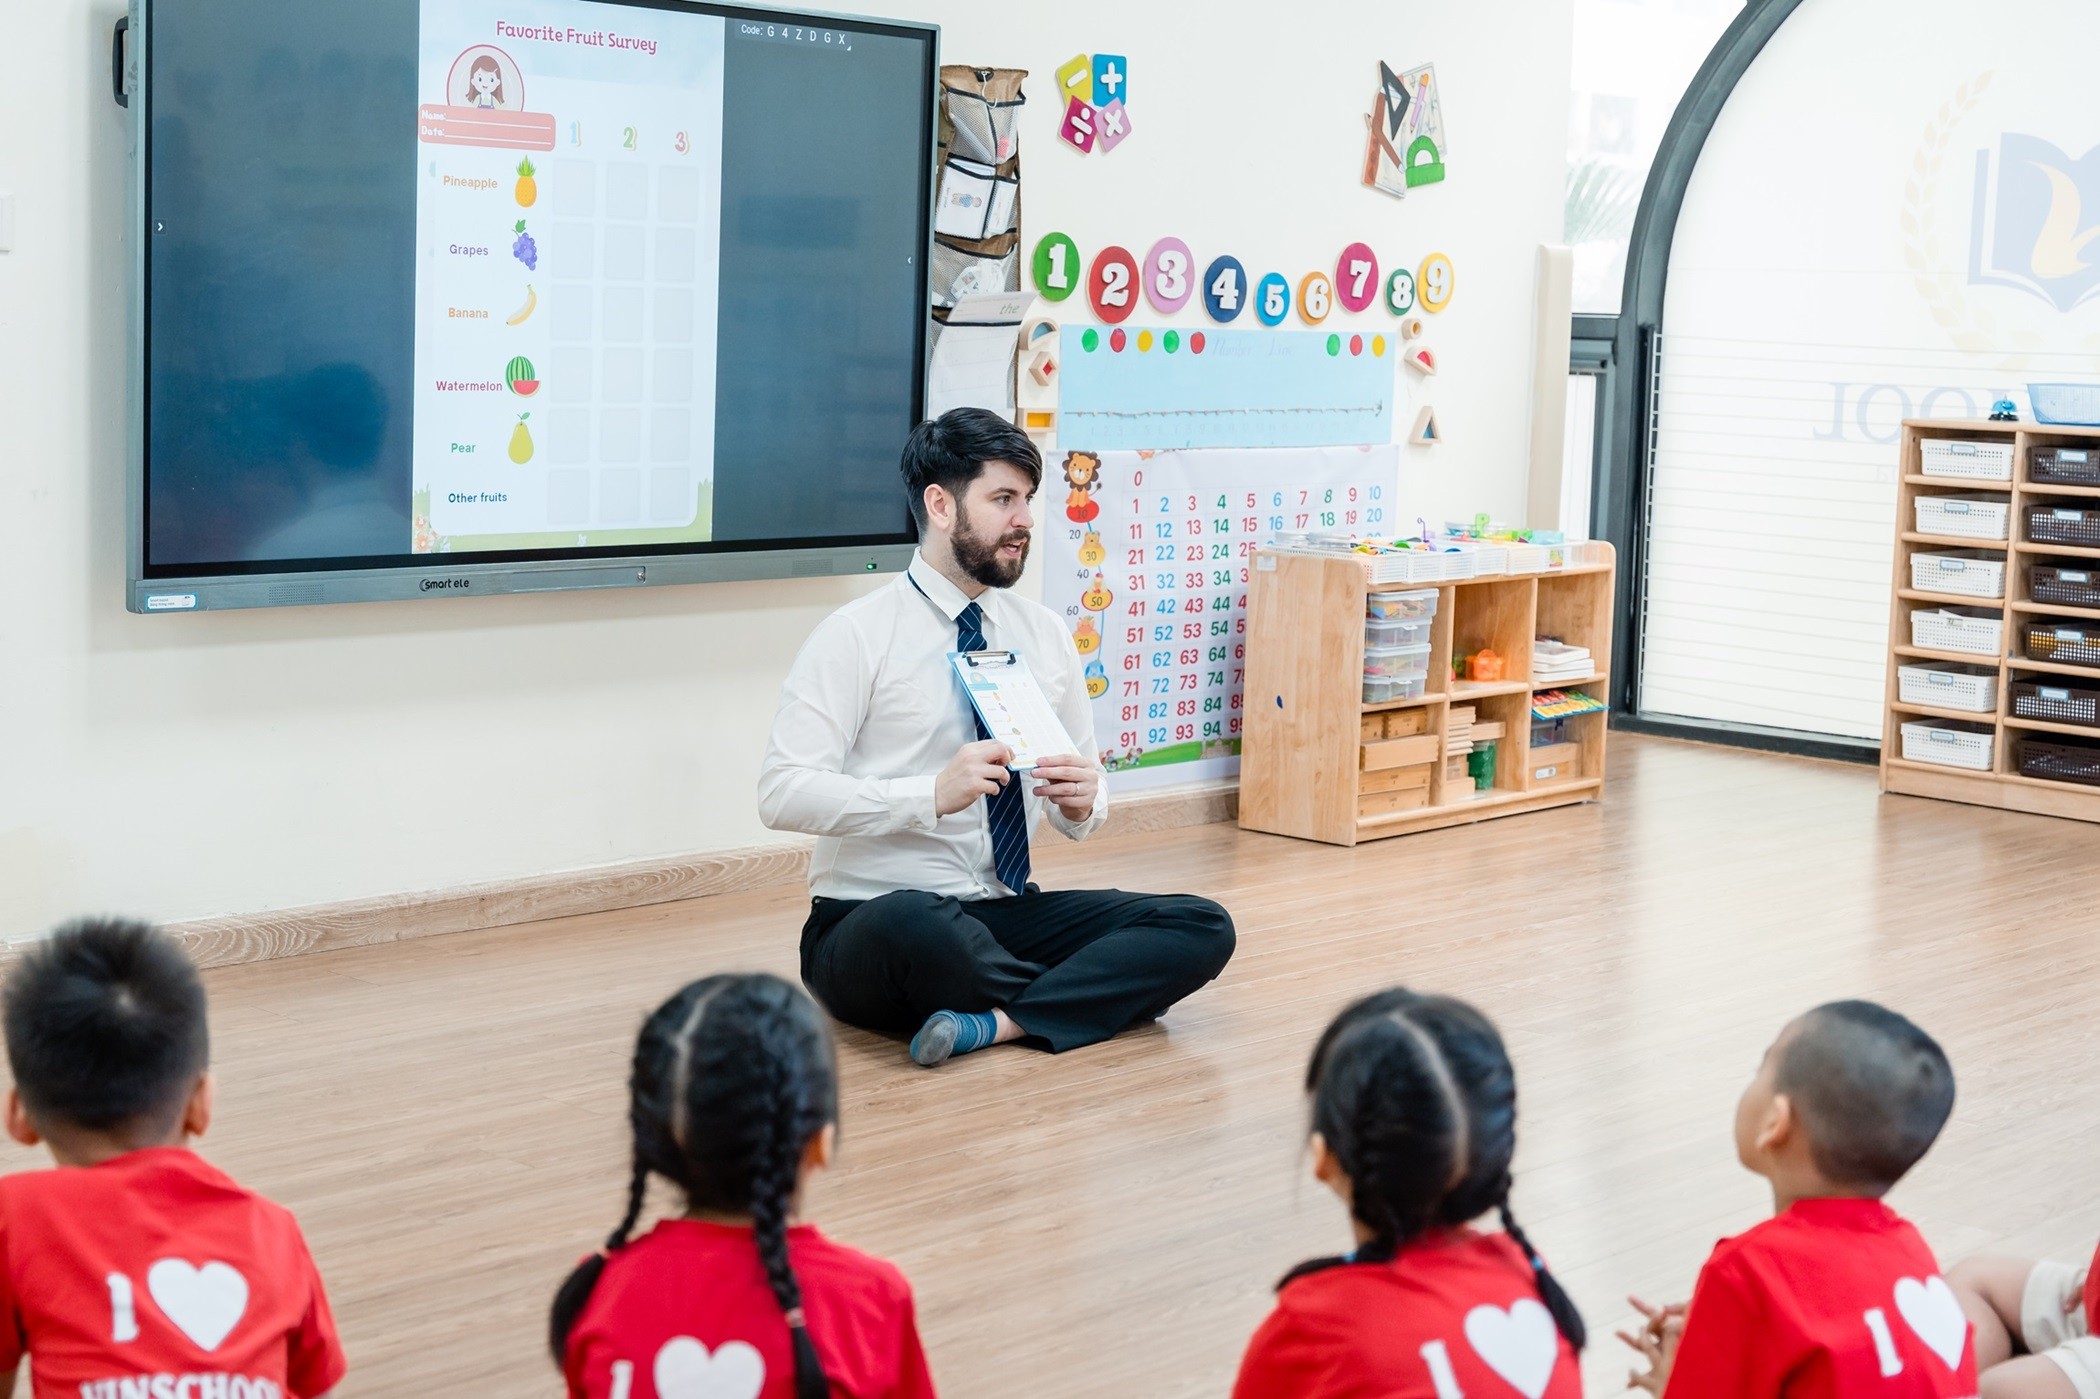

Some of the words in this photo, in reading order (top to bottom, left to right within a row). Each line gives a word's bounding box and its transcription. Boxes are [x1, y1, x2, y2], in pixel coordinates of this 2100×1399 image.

[496, 20, 563, 42] Favorite
[567, 28, 604, 47] Fruit
[608, 33, 657, 55] Survey
[741, 24, 763, 36] Code:
[421, 109, 446, 121] Name:
[421, 126, 445, 138] Date:
[569, 121, 579, 144] 1
[623, 126, 635, 149] 2
[674, 131, 687, 153] 3
[443, 175, 498, 190] Pineapple
[449, 244, 489, 258] Grapes
[1047, 243, 1068, 289] 1
[1100, 262, 1130, 307] 2
[1156, 250, 1187, 299] 3
[1211, 268, 1239, 310] 4
[1264, 283, 1285, 317] 5
[1305, 278, 1329, 319] 6
[1350, 259, 1372, 298] 7
[1391, 274, 1412, 309] 8
[1426, 260, 1451, 304] 9
[448, 307, 489, 319] Banana
[999, 303, 1020, 315] the
[436, 380, 503, 392] Watermelon
[451, 442, 476, 454] Pear
[1134, 471, 1142, 486] 0
[448, 492, 479, 503] Other
[480, 491, 508, 502] fruits
[1133, 499, 1138, 513] 1
[1161, 497, 1168, 512] 2
[1189, 496, 1196, 511] 3
[1217, 495, 1226, 509] 4
[1247, 494, 1255, 508] 5
[1274, 492, 1281, 506] 6
[1300, 491, 1307, 505] 7
[1324, 489, 1332, 503] 8
[1349, 488, 1356, 501] 9
[1370, 486, 1381, 500] 10
[1077, 509, 1087, 518] 10
[1130, 524, 1141, 539] 11
[1156, 523, 1171, 537] 12
[1187, 520, 1201, 534] 13
[1214, 519, 1229, 533] 14
[1243, 517, 1257, 532] 15
[1269, 516, 1283, 530] 16
[1296, 514, 1308, 528] 17
[1320, 512, 1335, 526] 18
[1346, 510, 1356, 524] 19
[1367, 508, 1382, 522] 20
[1069, 530, 1080, 539] 20
[1086, 551, 1096, 561] 30
[1128, 549, 1143, 564] 21
[1156, 545, 1174, 560] 22
[1187, 546, 1203, 561] 23
[1212, 544, 1229, 559] 24
[1077, 569, 1089, 579] 40
[1129, 575, 1144, 590] 31
[1157, 573, 1175, 589] 32
[1186, 573, 1203, 588] 33
[1214, 570, 1231, 585] 34
[454, 579, 469, 588] ele
[1092, 596, 1102, 606] 50
[1129, 601, 1145, 616] 41
[1157, 599, 1175, 613] 42
[1185, 598, 1203, 613] 43
[1213, 597, 1230, 611] 44
[1067, 606, 1078, 615] 60
[1127, 627, 1143, 643] 51
[1155, 626, 1173, 641] 52
[1184, 623, 1201, 638] 53
[1211, 621, 1228, 636] 54
[1078, 639, 1089, 648] 70
[1124, 654, 1140, 670] 61
[1153, 652, 1171, 667] 62
[1181, 649, 1198, 664] 63
[1209, 646, 1226, 661] 64
[1235, 644, 1245, 659] 6
[1124, 681, 1139, 697] 71
[1153, 678, 1169, 693] 72
[1180, 674, 1196, 690] 73
[1208, 671, 1223, 686] 74
[1234, 669, 1244, 684] 7
[1122, 705, 1138, 721] 81
[1149, 703, 1167, 718] 82
[1177, 700, 1195, 716] 83
[1204, 697, 1221, 712] 84
[1121, 732, 1136, 747] 91
[1149, 728, 1166, 743] 92
[1176, 724, 1193, 740] 93
[1203, 721, 1220, 736] 94
[106, 1271, 140, 1343] I
[1863, 1307, 1904, 1378] I
[1419, 1338, 1464, 1399] I
